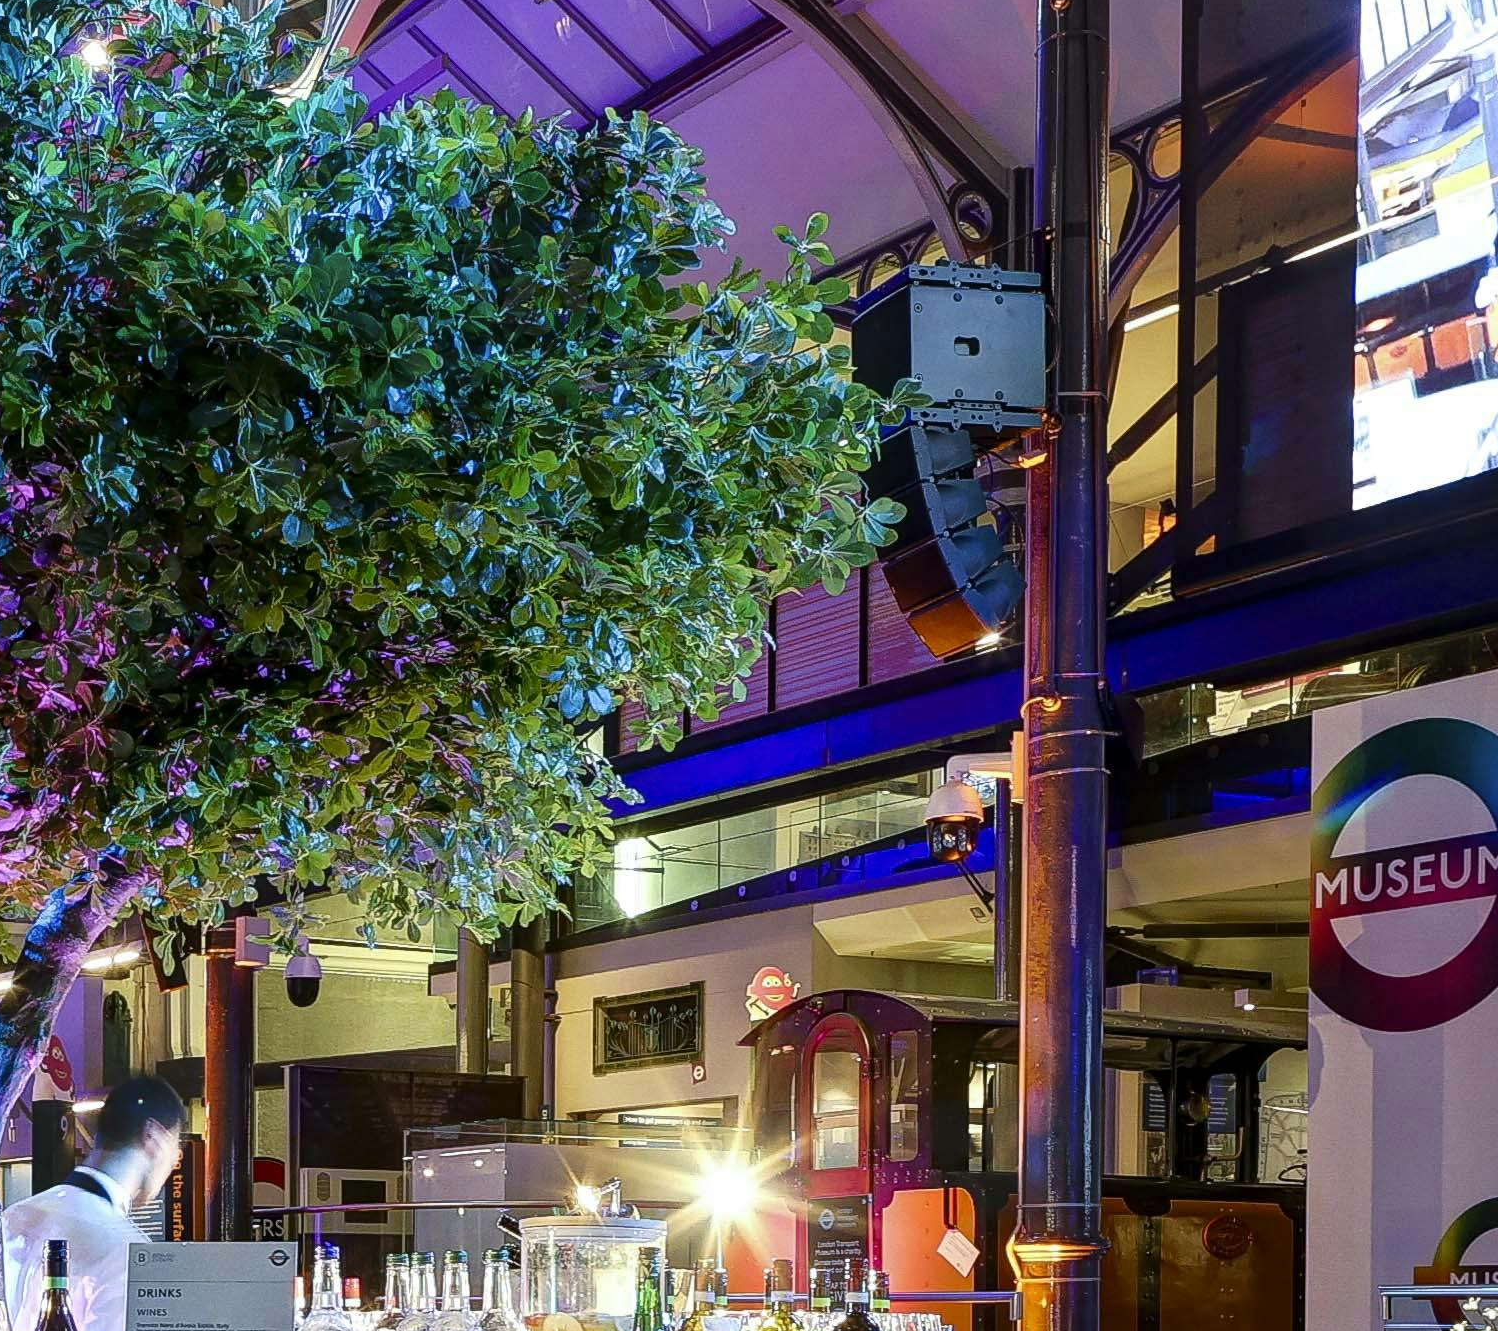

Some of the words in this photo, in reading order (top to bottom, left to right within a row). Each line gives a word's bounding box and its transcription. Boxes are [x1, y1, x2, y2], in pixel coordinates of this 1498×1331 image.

[173, 1170, 184, 1199] the
[138, 1288, 182, 1298] DRINKS
[137, 1308, 167, 1317] WINES
